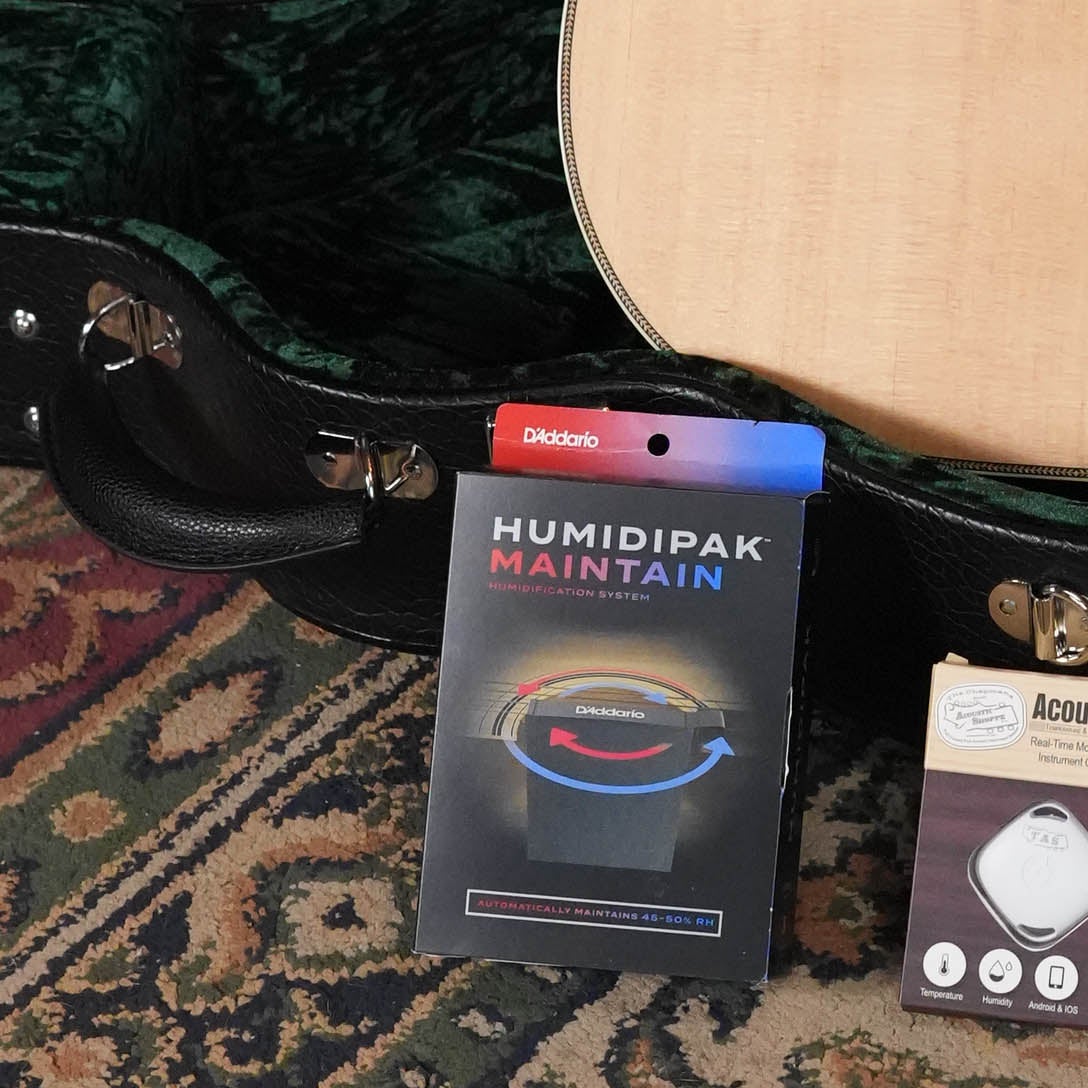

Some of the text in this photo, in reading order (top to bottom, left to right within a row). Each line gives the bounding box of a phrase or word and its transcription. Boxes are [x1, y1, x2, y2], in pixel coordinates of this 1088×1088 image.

[489, 548, 723, 591] MAINTAIN
[488, 581, 650, 601] HUMIDIFICATION SYSTEM
[1030, 736, 1074, 751] Real-Time
[1038, 752, 1083, 767] Instrument
[477, 899, 571, 915] AUTOMATICALLY
[574, 907, 638, 921] MAINTAINS
[695, 917, 715, 927] RH
[921, 987, 964, 1001] Temperature
[982, 995, 1014, 1008] Humidity
[1028, 1000, 1056, 1013] Android
[1056, 1004, 1063, 1013] &
